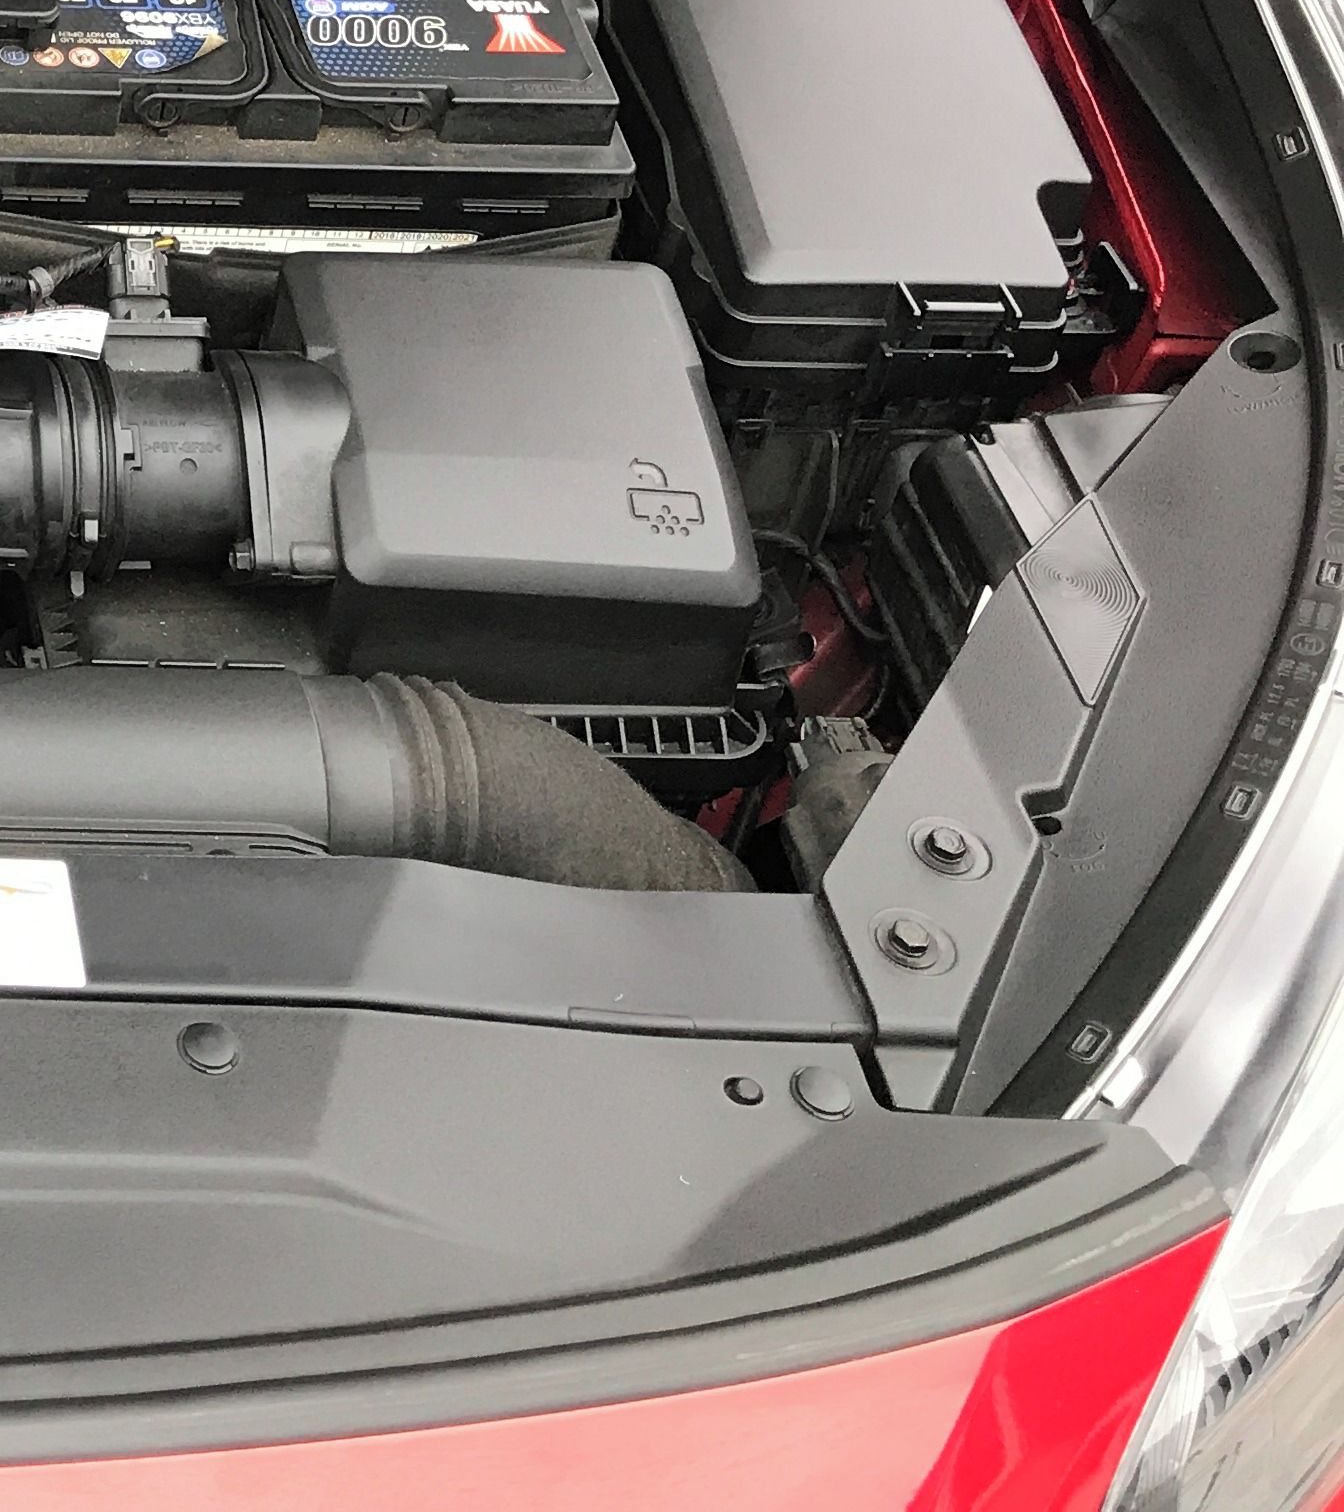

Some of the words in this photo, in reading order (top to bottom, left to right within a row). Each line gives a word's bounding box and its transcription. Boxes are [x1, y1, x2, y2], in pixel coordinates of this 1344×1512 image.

[465, 0, 550, 14] YUASA
[120, 10, 216, 24] YBX9096
[307, 15, 447, 48] 9000
[373, 232, 395, 240] 2018
